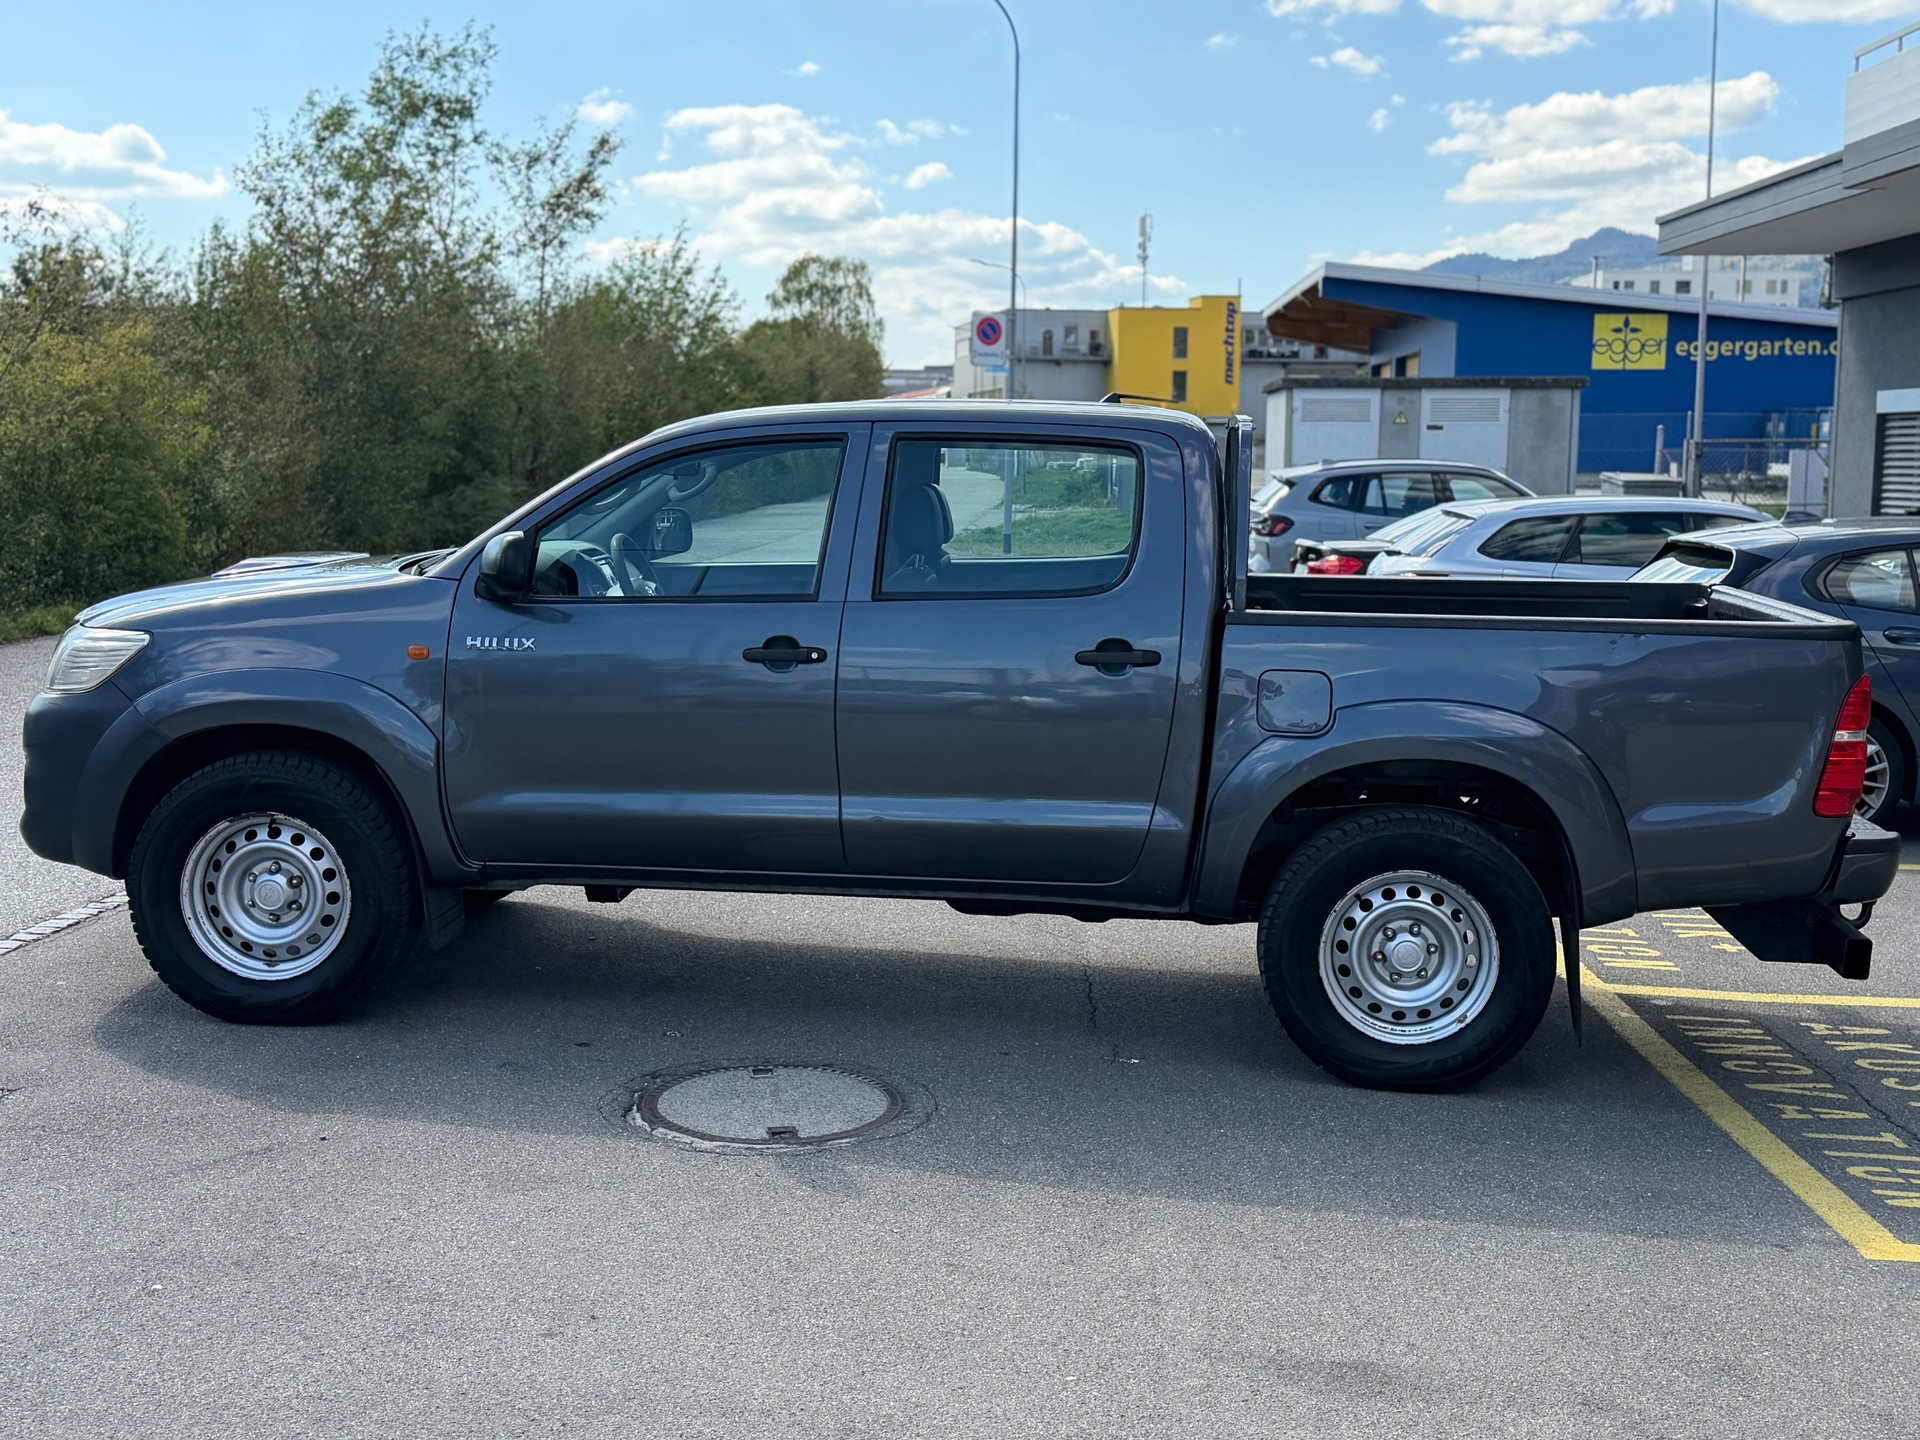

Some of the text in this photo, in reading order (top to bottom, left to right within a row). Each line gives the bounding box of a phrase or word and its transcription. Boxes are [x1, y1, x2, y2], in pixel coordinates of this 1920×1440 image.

[1224, 301, 1238, 385] mechtop
[1593, 337, 1667, 364] egger
[466, 636, 536, 651] HILUX
